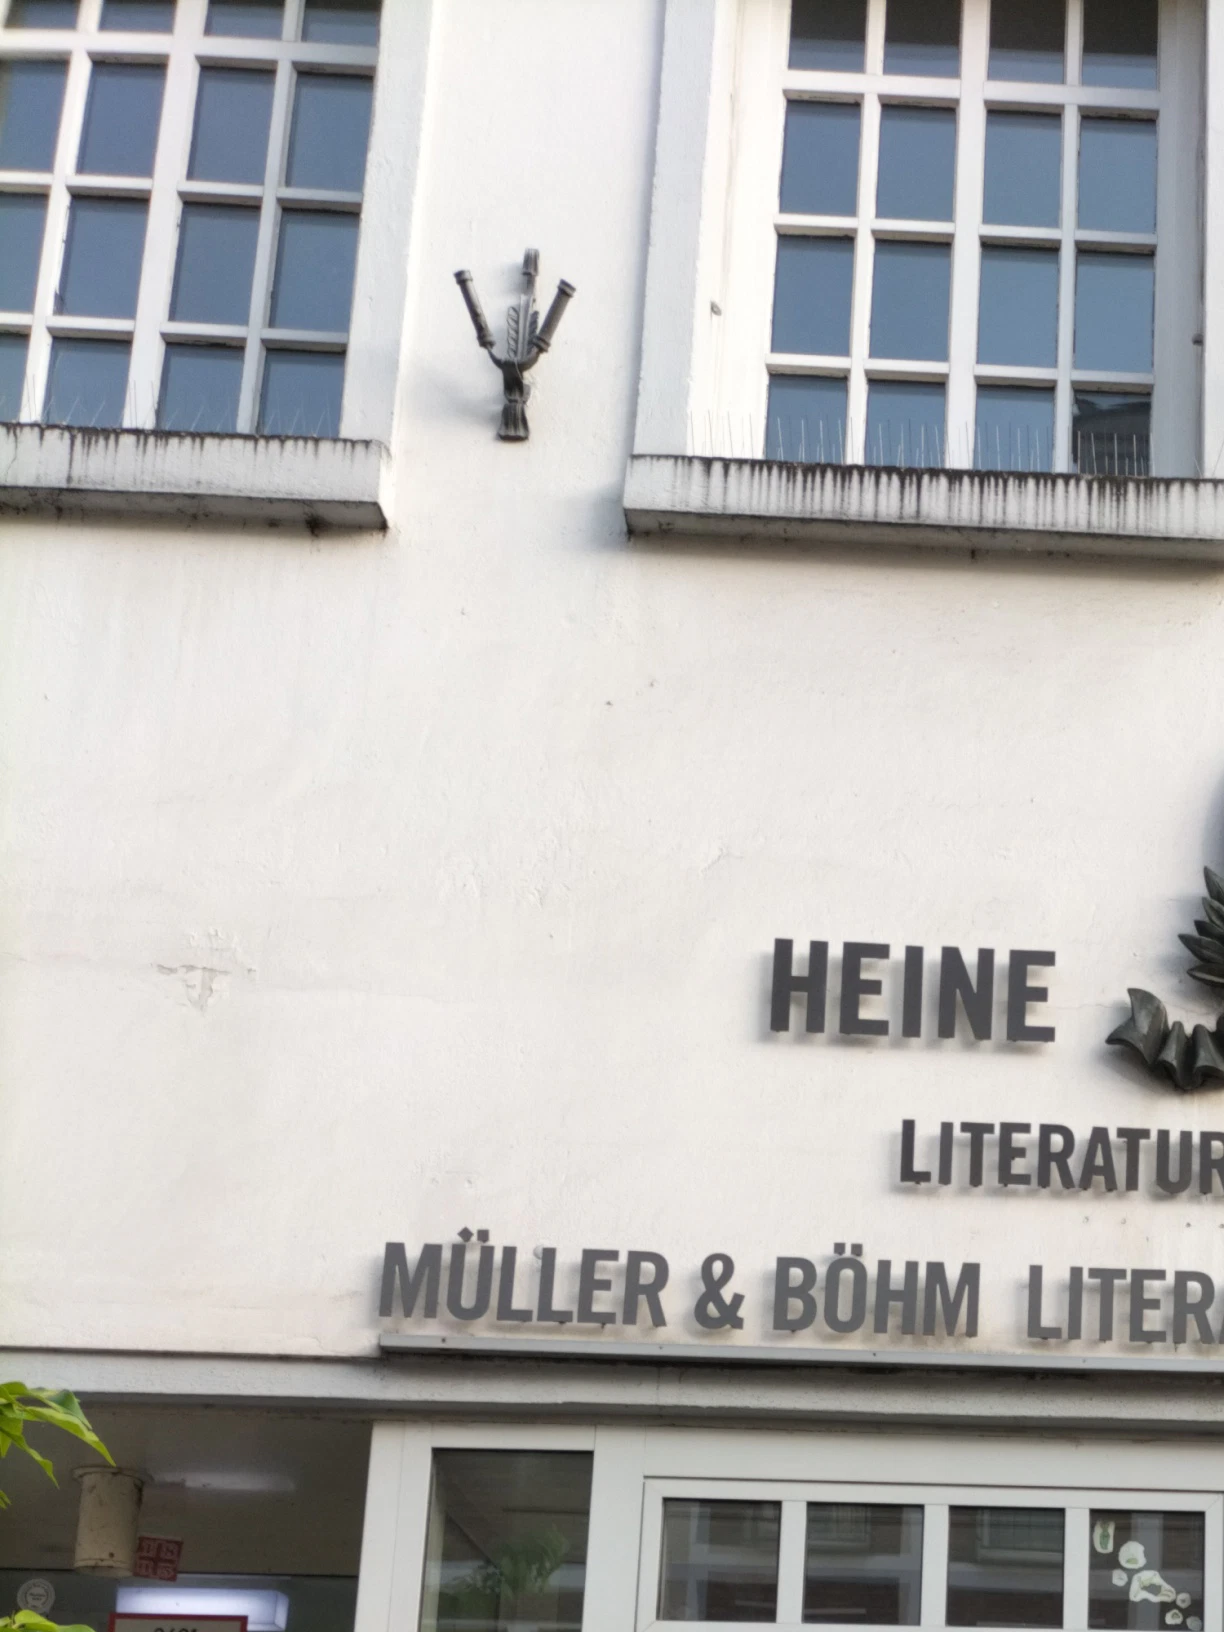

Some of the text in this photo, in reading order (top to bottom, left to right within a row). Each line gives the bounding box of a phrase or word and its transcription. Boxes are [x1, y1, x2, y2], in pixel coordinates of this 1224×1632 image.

[770, 937, 1056, 1044] HEINE
[378, 1227, 670, 1328] MÜLLER
[693, 1251, 746, 1331] &
[771, 1241, 982, 1339] BÖHM
